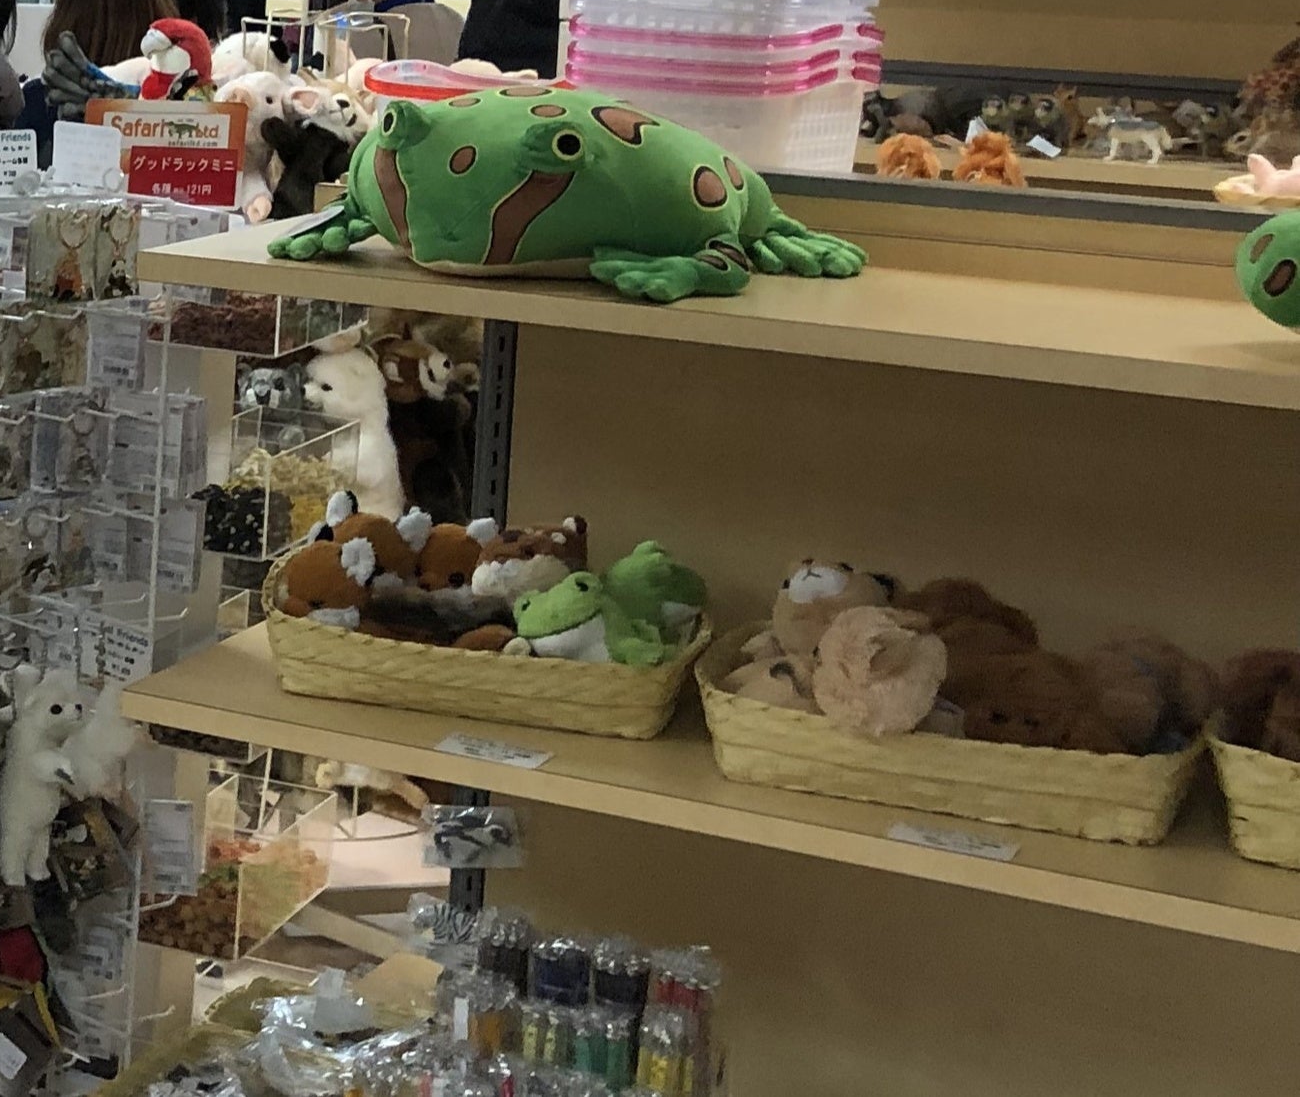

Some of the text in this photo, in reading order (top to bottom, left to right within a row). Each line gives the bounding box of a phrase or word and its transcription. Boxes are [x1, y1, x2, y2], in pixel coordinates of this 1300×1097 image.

[111, 115, 166, 138] Safari
[1, 132, 32, 143] Friends
[132, 155, 236, 173] グッドラックミニ
